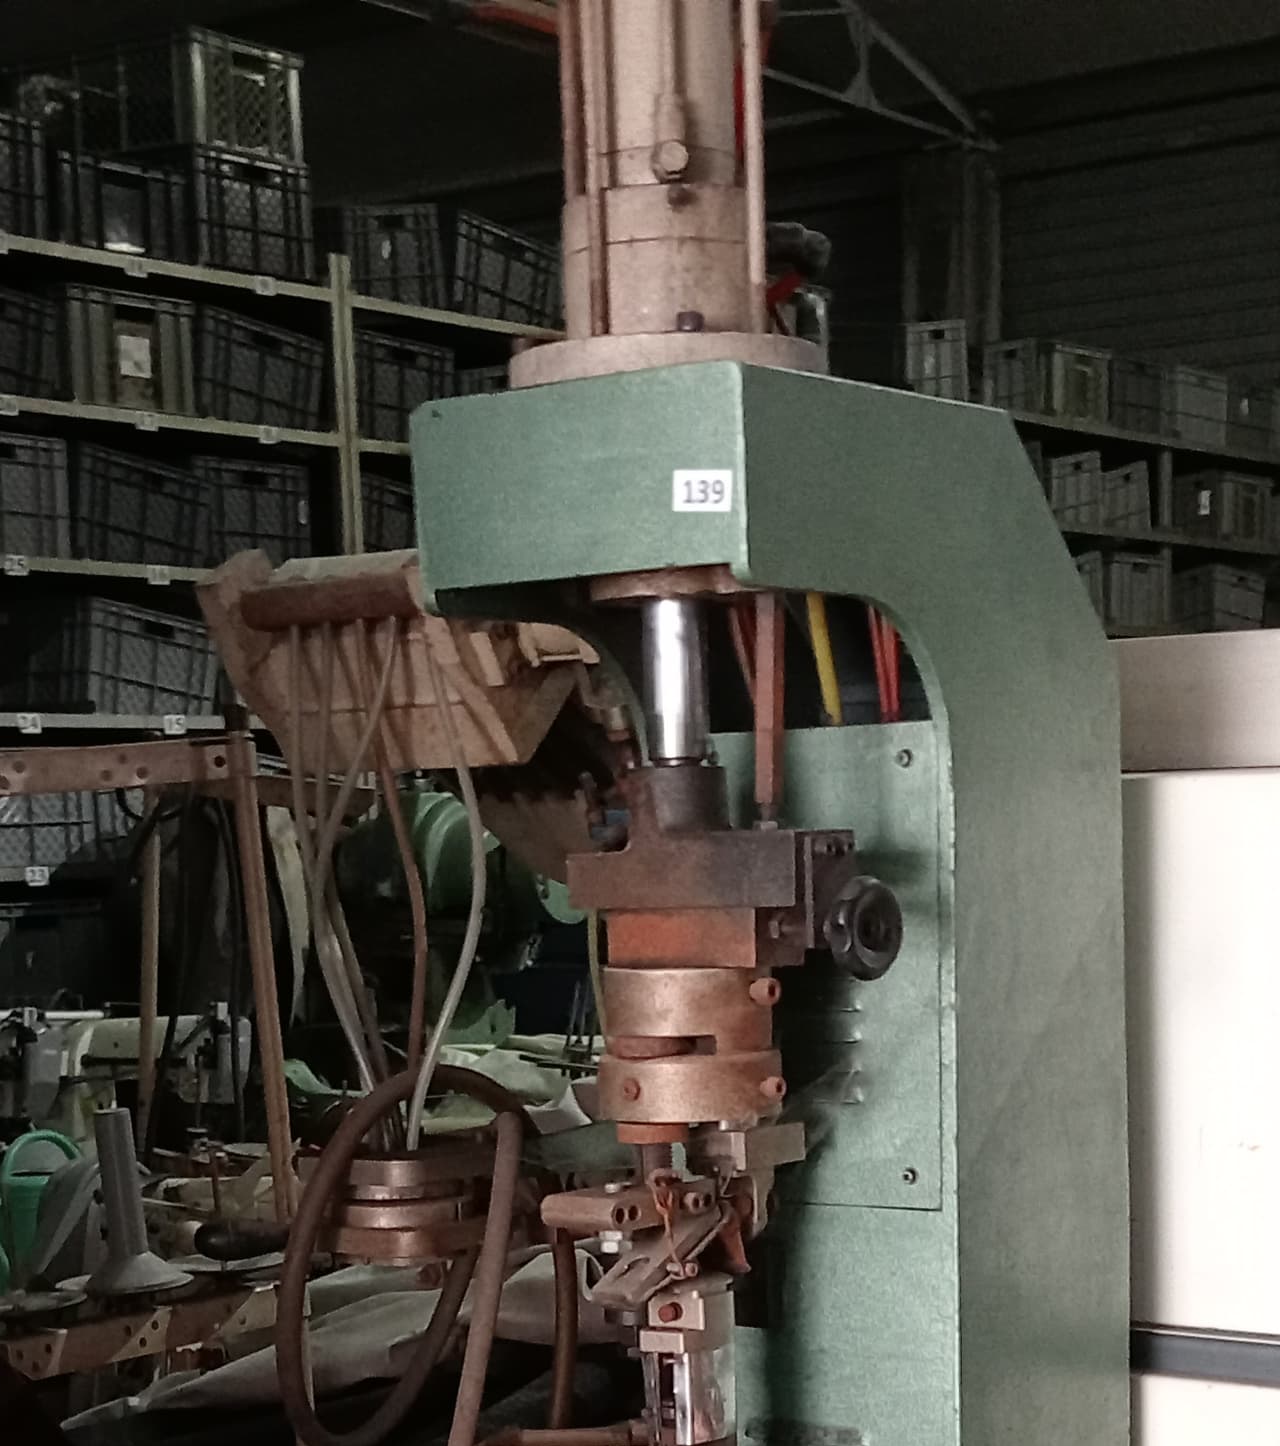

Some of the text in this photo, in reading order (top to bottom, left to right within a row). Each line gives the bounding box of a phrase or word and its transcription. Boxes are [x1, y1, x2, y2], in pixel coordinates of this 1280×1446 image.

[682, 479, 726, 505] 139
[167, 715, 184, 731] 15
[28, 868, 49, 884] 23
